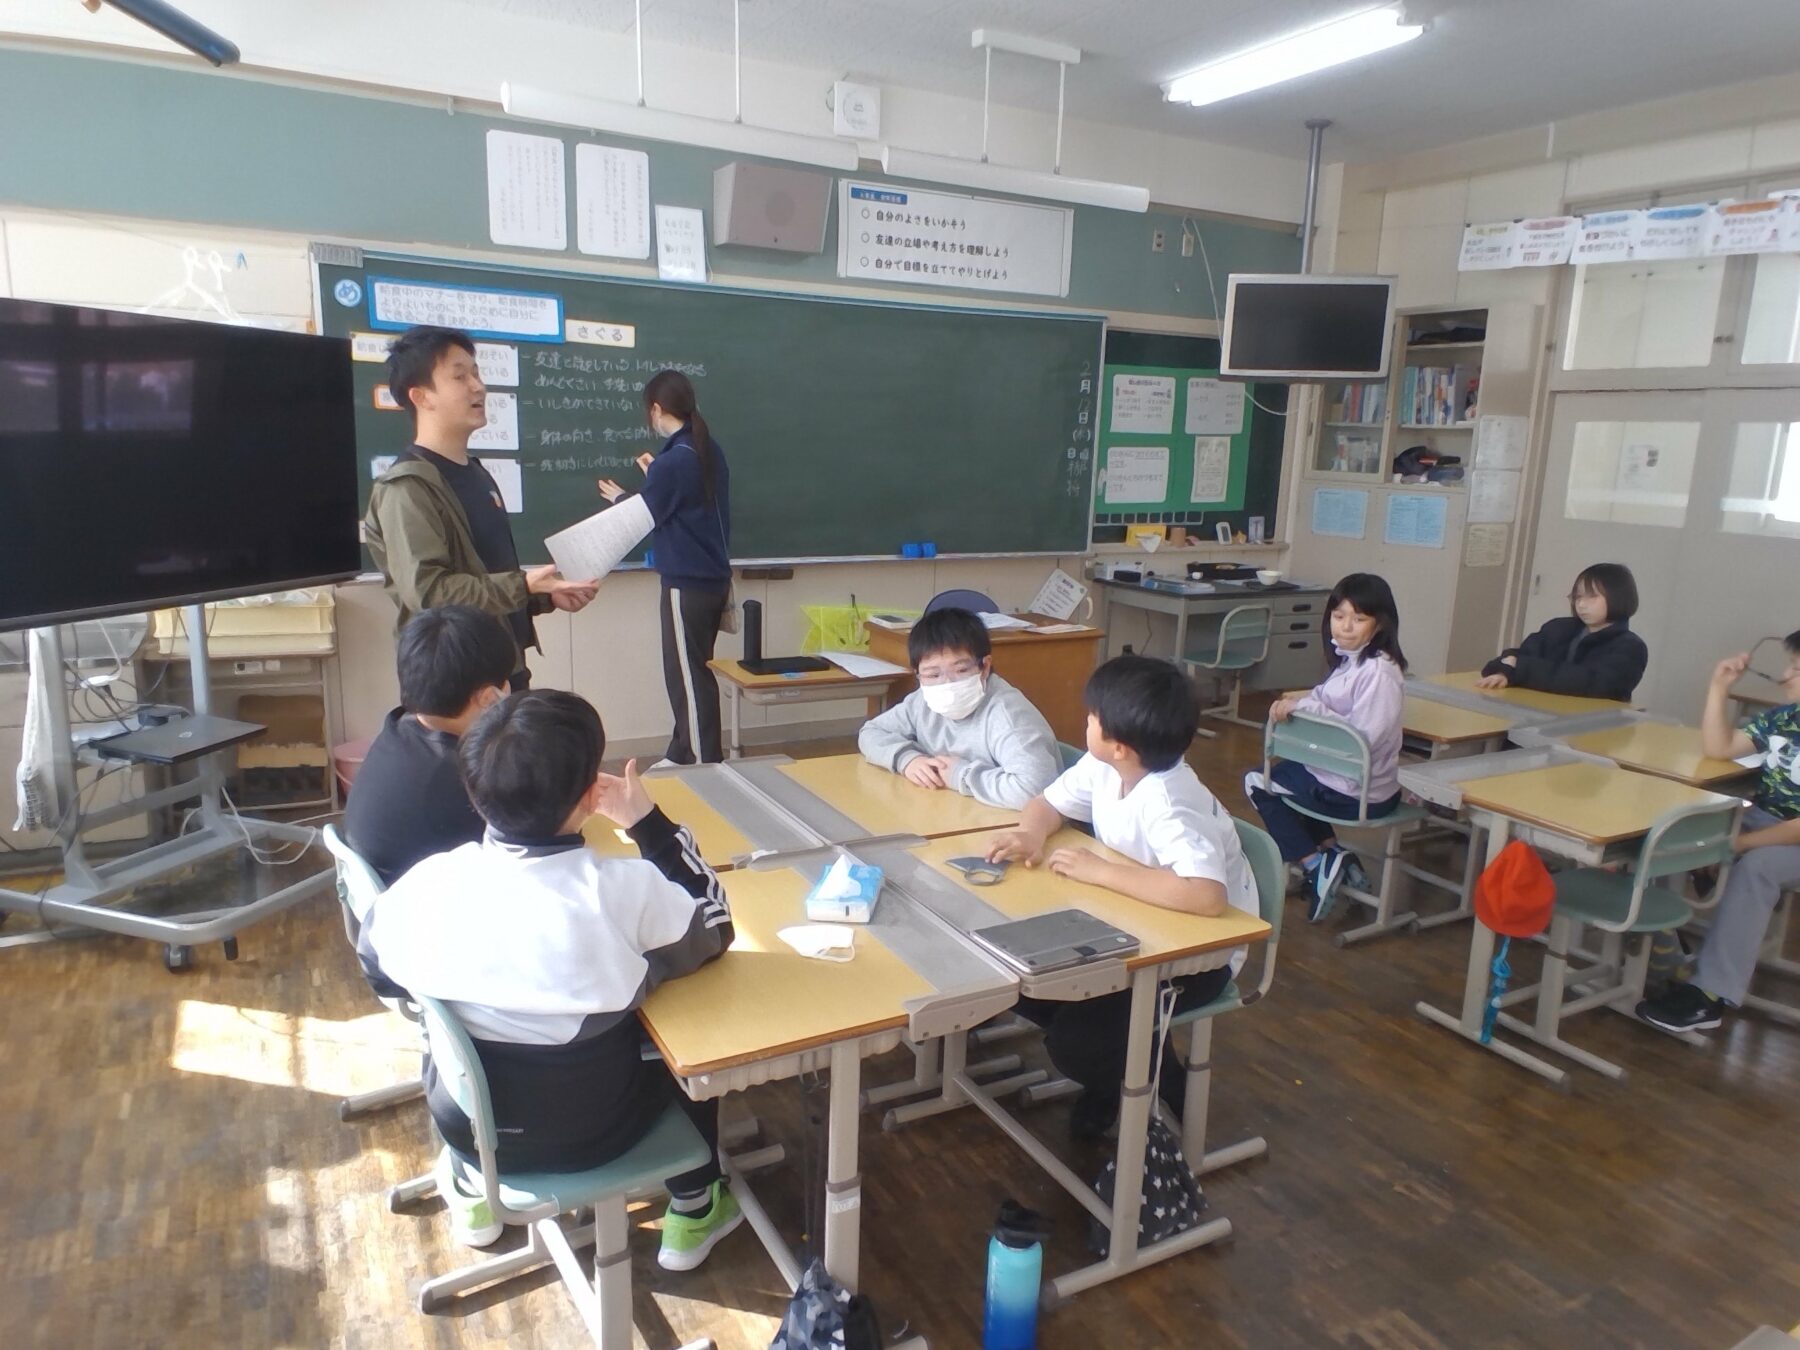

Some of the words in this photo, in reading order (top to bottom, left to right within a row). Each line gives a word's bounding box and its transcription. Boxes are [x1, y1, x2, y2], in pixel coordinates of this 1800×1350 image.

[875, 208, 967, 232] 自分のよさをいかそう
[875, 233, 1010, 259] 友達の立場や考え方を理解しよう
[875, 257, 1009, 281] 自分で目標を立ててやりとげよう
[336, 282, 362, 305] め
[380, 284, 548, 310] 給食中のマナーを守り、給食時間を
[380, 297, 540, 322] よりよいものにするために自分に
[577, 324, 624, 343] さぐる
[534, 374, 598, 392] めんどくさい
